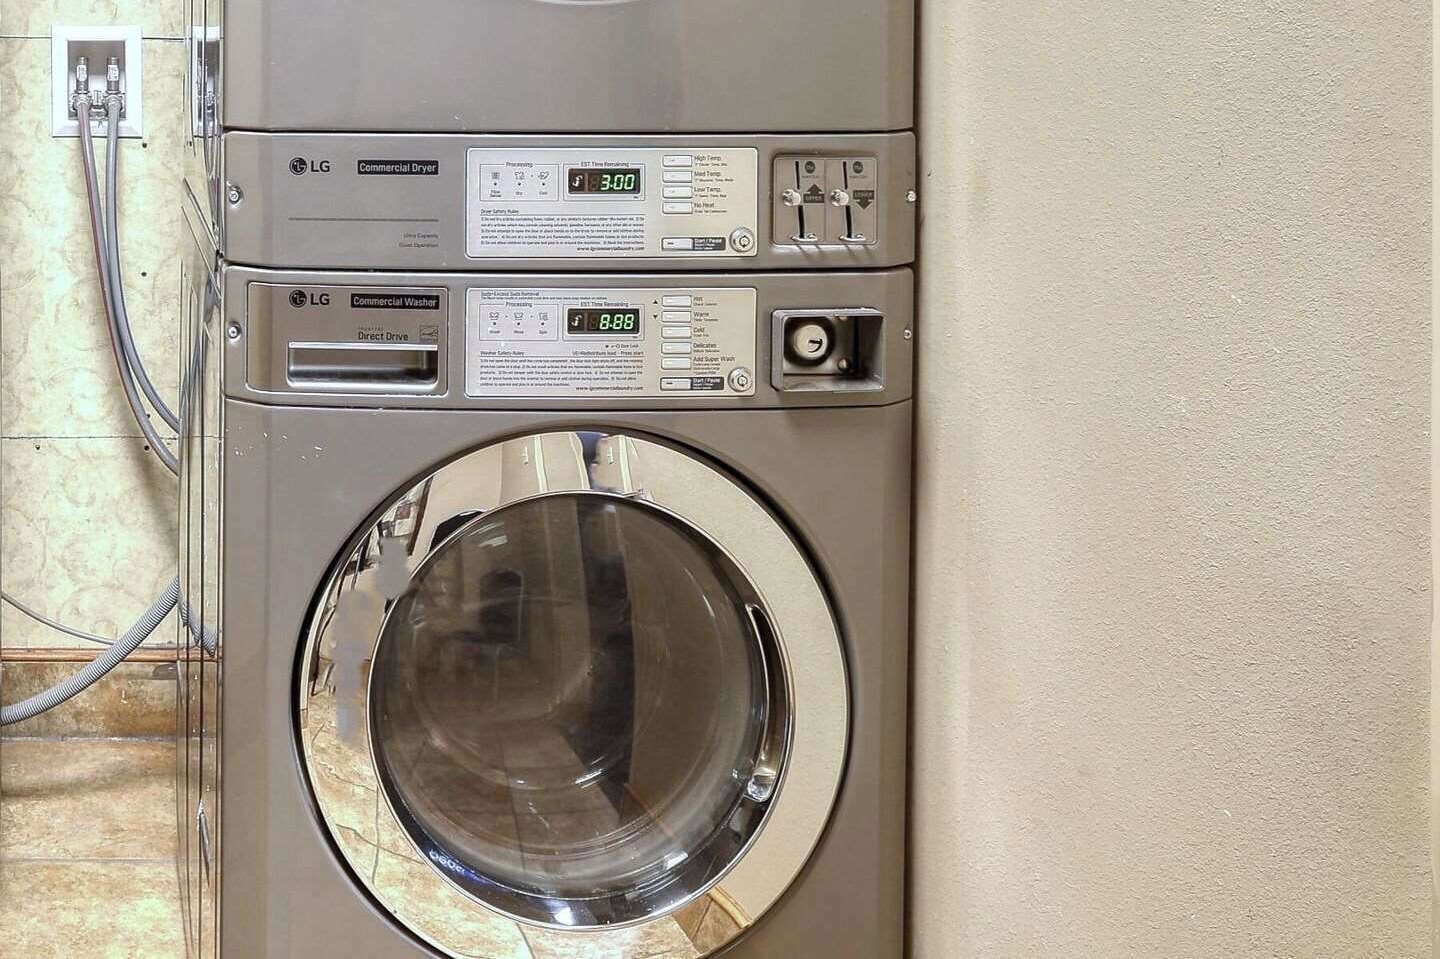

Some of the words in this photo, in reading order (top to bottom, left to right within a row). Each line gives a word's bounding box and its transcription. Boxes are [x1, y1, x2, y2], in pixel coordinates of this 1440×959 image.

[311, 161, 330, 172] LG
[360, 163, 409, 172] Commercial
[412, 164, 436, 173] Dryer
[311, 294, 330, 305] LG
[354, 297, 402, 306] Commercial
[404, 297, 436, 307] Washer
[358, 332, 383, 340] Direct
[386, 332, 408, 341] Drive
